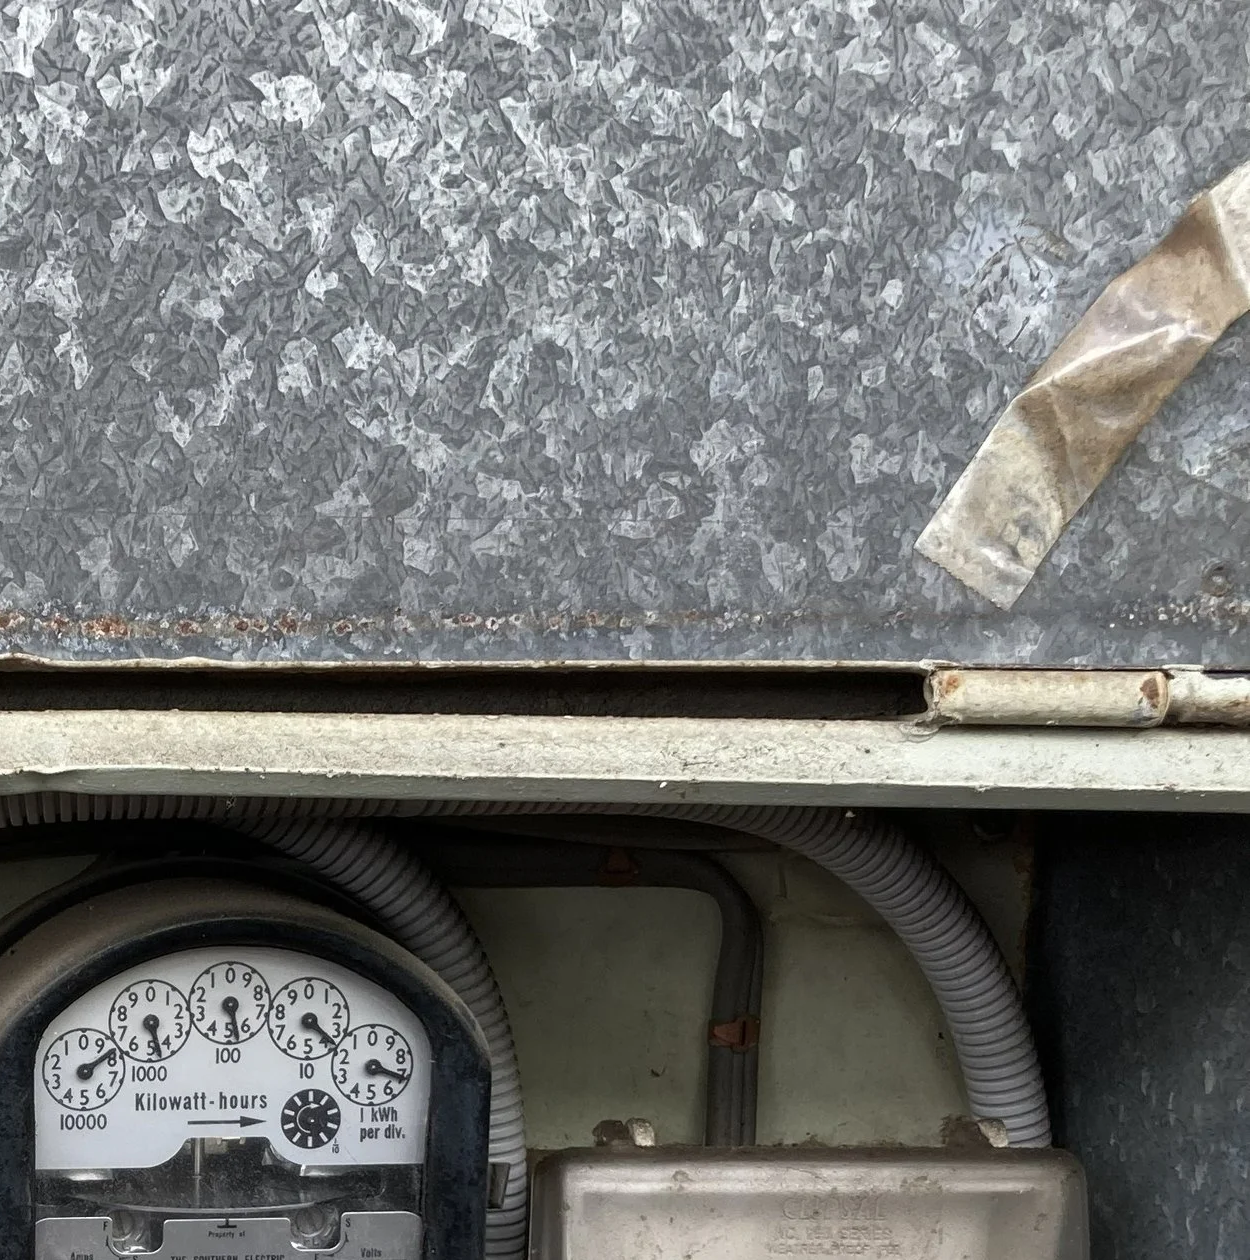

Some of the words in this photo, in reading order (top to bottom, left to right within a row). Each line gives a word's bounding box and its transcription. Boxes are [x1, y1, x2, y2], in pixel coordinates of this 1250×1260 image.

[216, 1048, 241, 1064] 100
[131, 1066, 167, 1082] 1000
[299, 1063, 314, 1079] 10
[371, 1107, 398, 1122] kWh
[59, 1115, 107, 1131] 10000
[360, 1127, 379, 1142] per
[384, 1124, 406, 1139] div.
[360, 1247, 382, 1258] Volts
